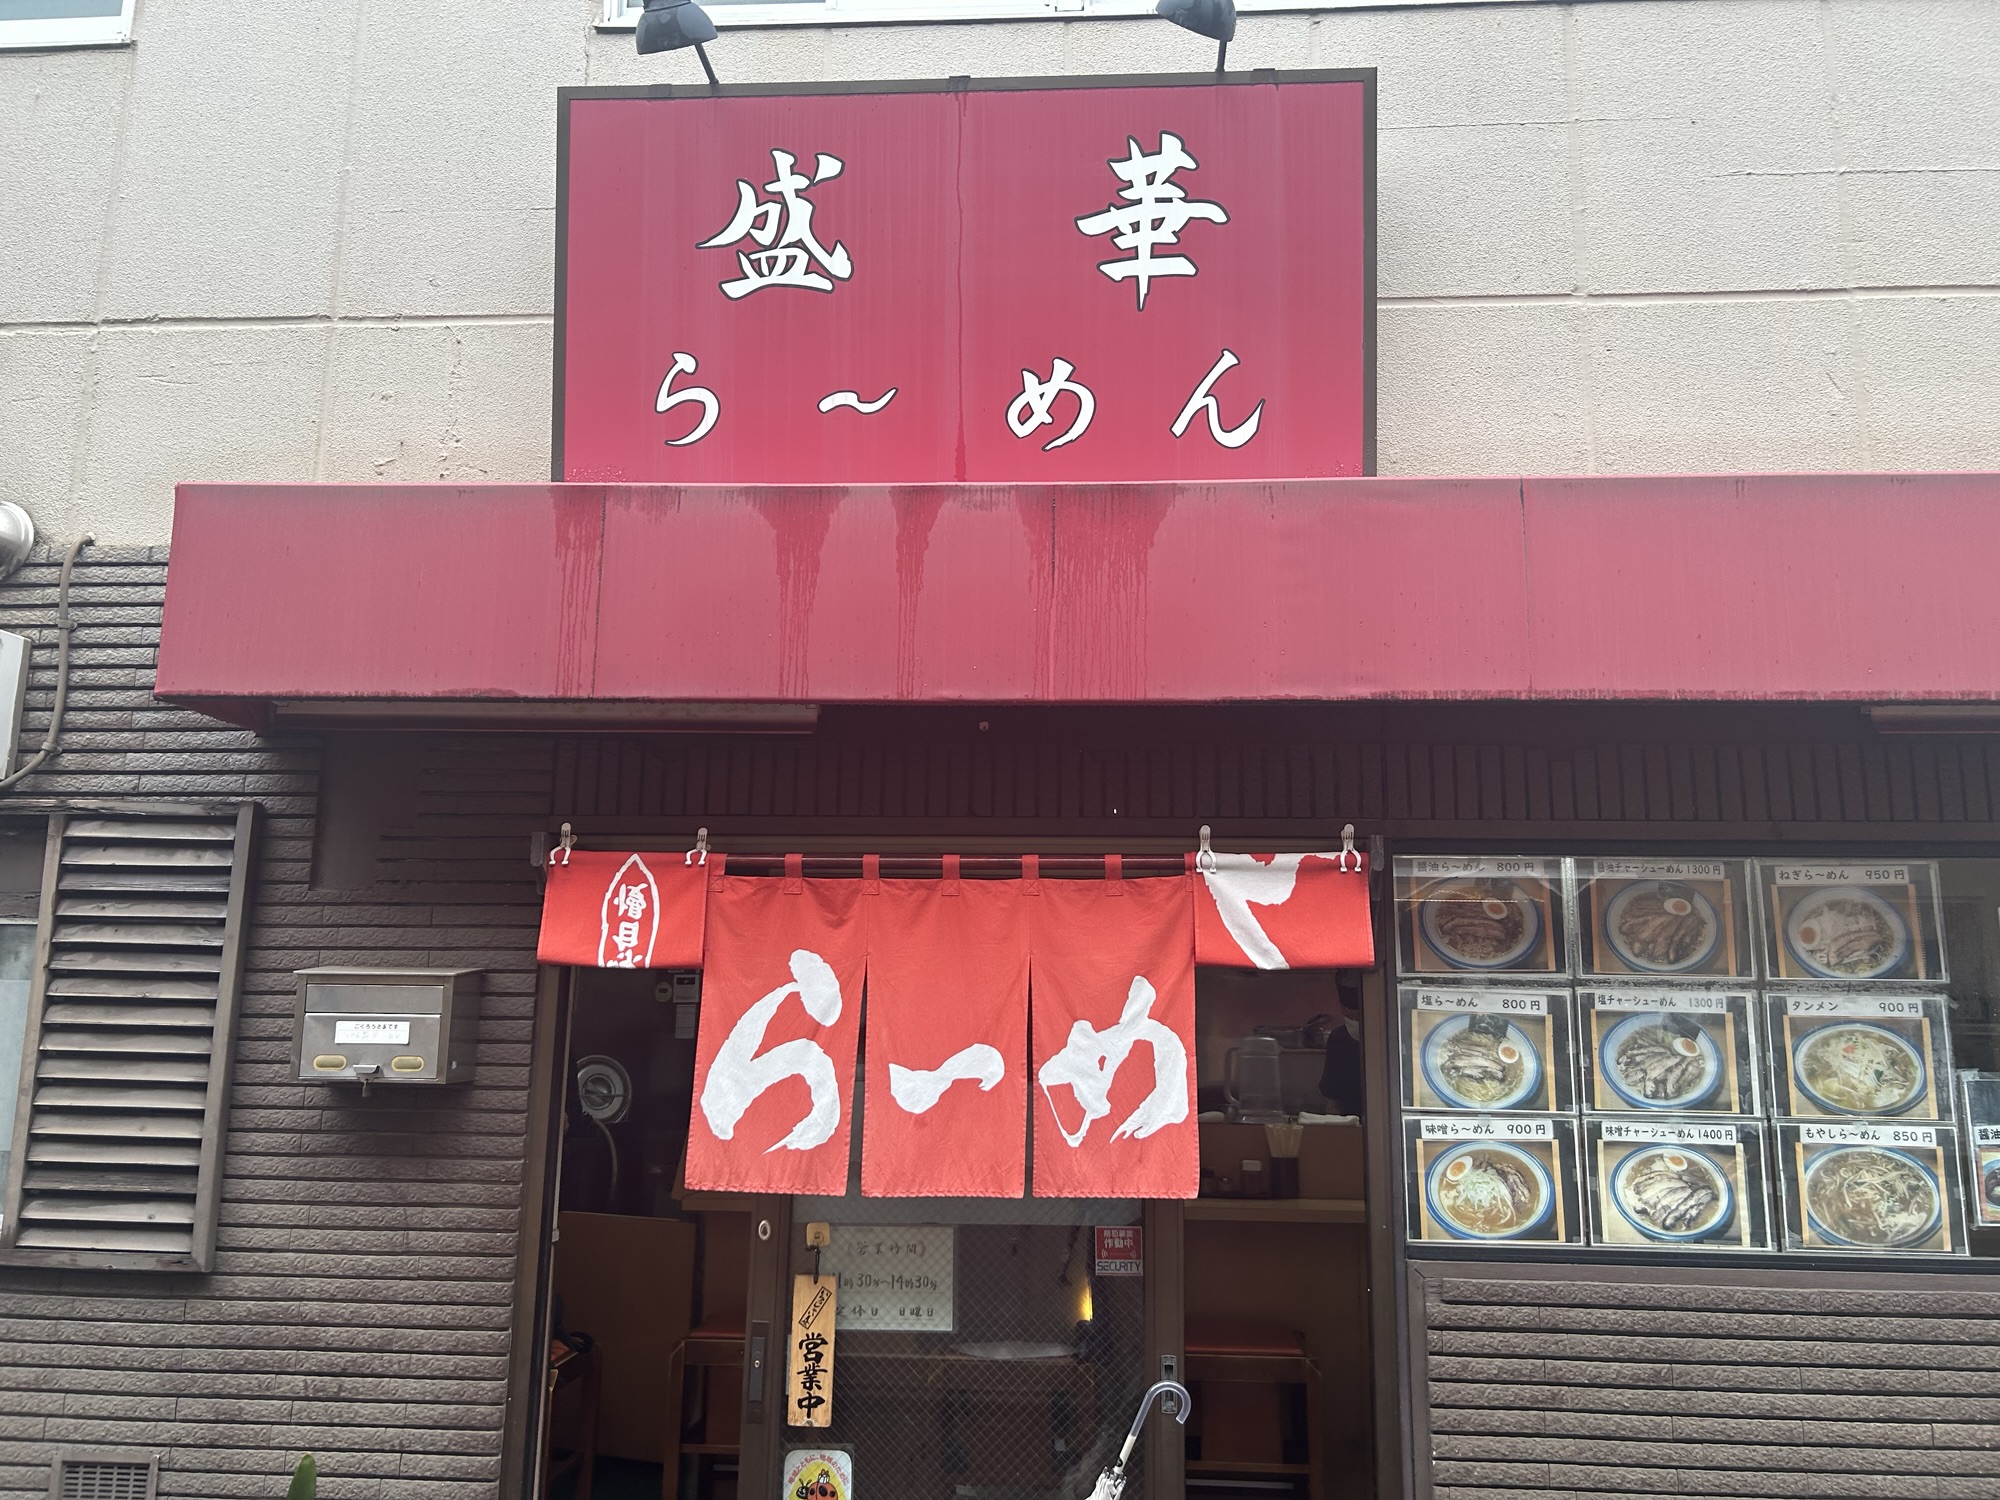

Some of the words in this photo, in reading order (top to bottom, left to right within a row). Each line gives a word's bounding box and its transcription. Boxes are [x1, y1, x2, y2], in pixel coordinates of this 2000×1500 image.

[696, 131, 1230, 312] 盛華
[654, 349, 1266, 451] ら〜めん
[1496, 862, 1535, 873] 800円
[1686, 864, 1721, 876] 1300円
[1779, 869, 1849, 881] ねぎら〜めん
[1865, 869, 1905, 881] 950円
[1421, 994, 1478, 1008] 塩ら〜めん
[1502, 999, 1541, 1011] 800円
[1597, 994, 1676, 1007] 塩チャーシューめん
[1689, 997, 1724, 1009] 1300円
[1792, 1000, 1839, 1012] タンメン
[1879, 1002, 1919, 1014] 900円
[1425, 1123, 1495, 1136] 味噌ら〜めん
[1507, 1124, 1546, 1135] 900円
[1605, 1125, 1695, 1140] 味噌チャーシューめん
[1698, 1129, 1734, 1141] 1400円
[1805, 1127, 1881, 1141] もやしら〜めん
[1893, 1131, 1933, 1143] 850円
[1103, 1237, 1134, 1249] 作動中
[1096, 1260, 1142, 1272] SECURITY
[796, 1332, 829, 1420] 営業中
